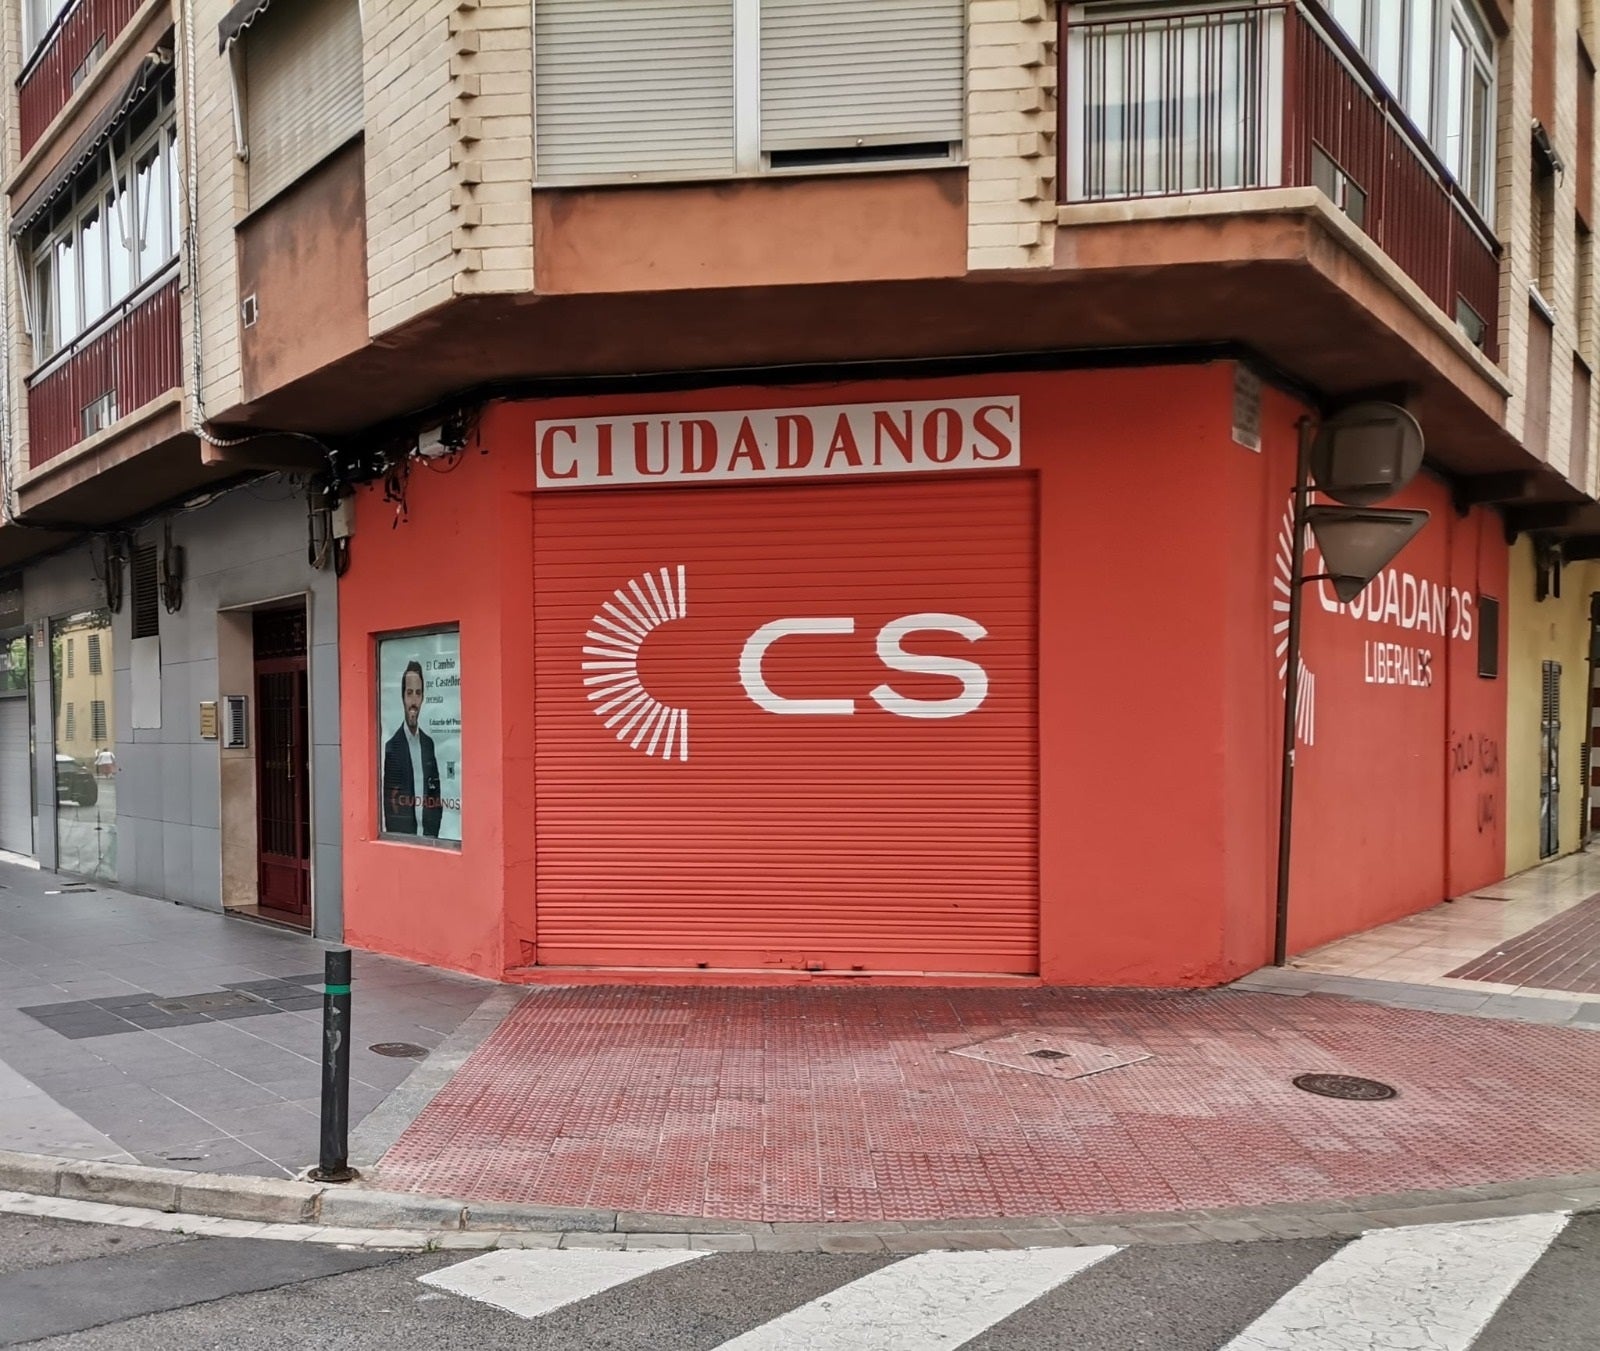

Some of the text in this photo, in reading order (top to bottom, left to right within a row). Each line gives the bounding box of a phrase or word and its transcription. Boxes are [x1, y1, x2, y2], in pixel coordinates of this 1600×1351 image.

[540, 405, 1015, 479] CIUDADANOS
[1318, 555, 1473, 641] CUDADANOS
[738, 612, 989, 718] CS
[1365, 640, 1432, 688] LIBERALES
